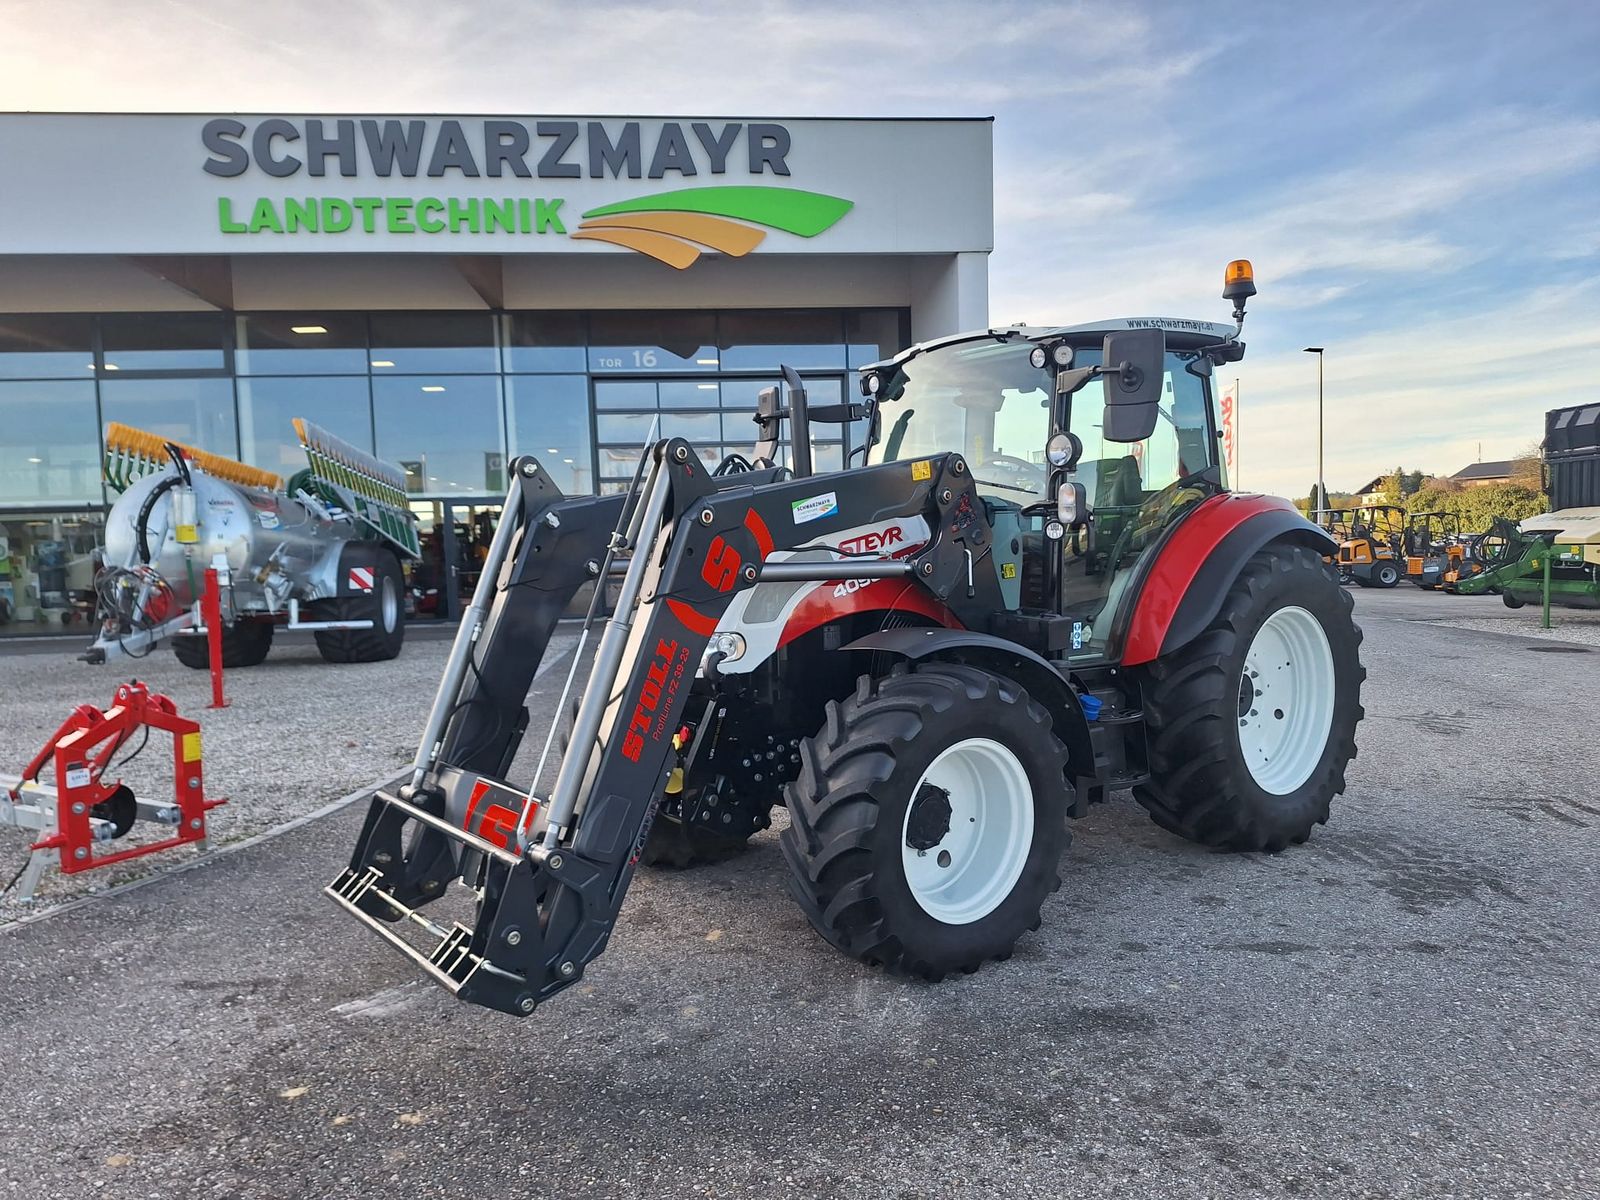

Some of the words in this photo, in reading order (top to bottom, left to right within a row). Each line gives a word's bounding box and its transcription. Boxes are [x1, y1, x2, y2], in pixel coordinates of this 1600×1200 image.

[202, 118, 791, 179] SCHWARZMAYR
[218, 197, 567, 234] LANDTECHNIK
[1127, 320, 1214, 332] www.schwarzmayr.at
[599, 358, 622, 368] TOR
[632, 350, 657, 368] 16
[838, 526, 903, 560] STEYR
[833, 578, 880, 598] 409
[621, 638, 679, 763] STOLL
[652, 697, 674, 742] ProfiLine
[677, 647, 690, 679] 39-23
